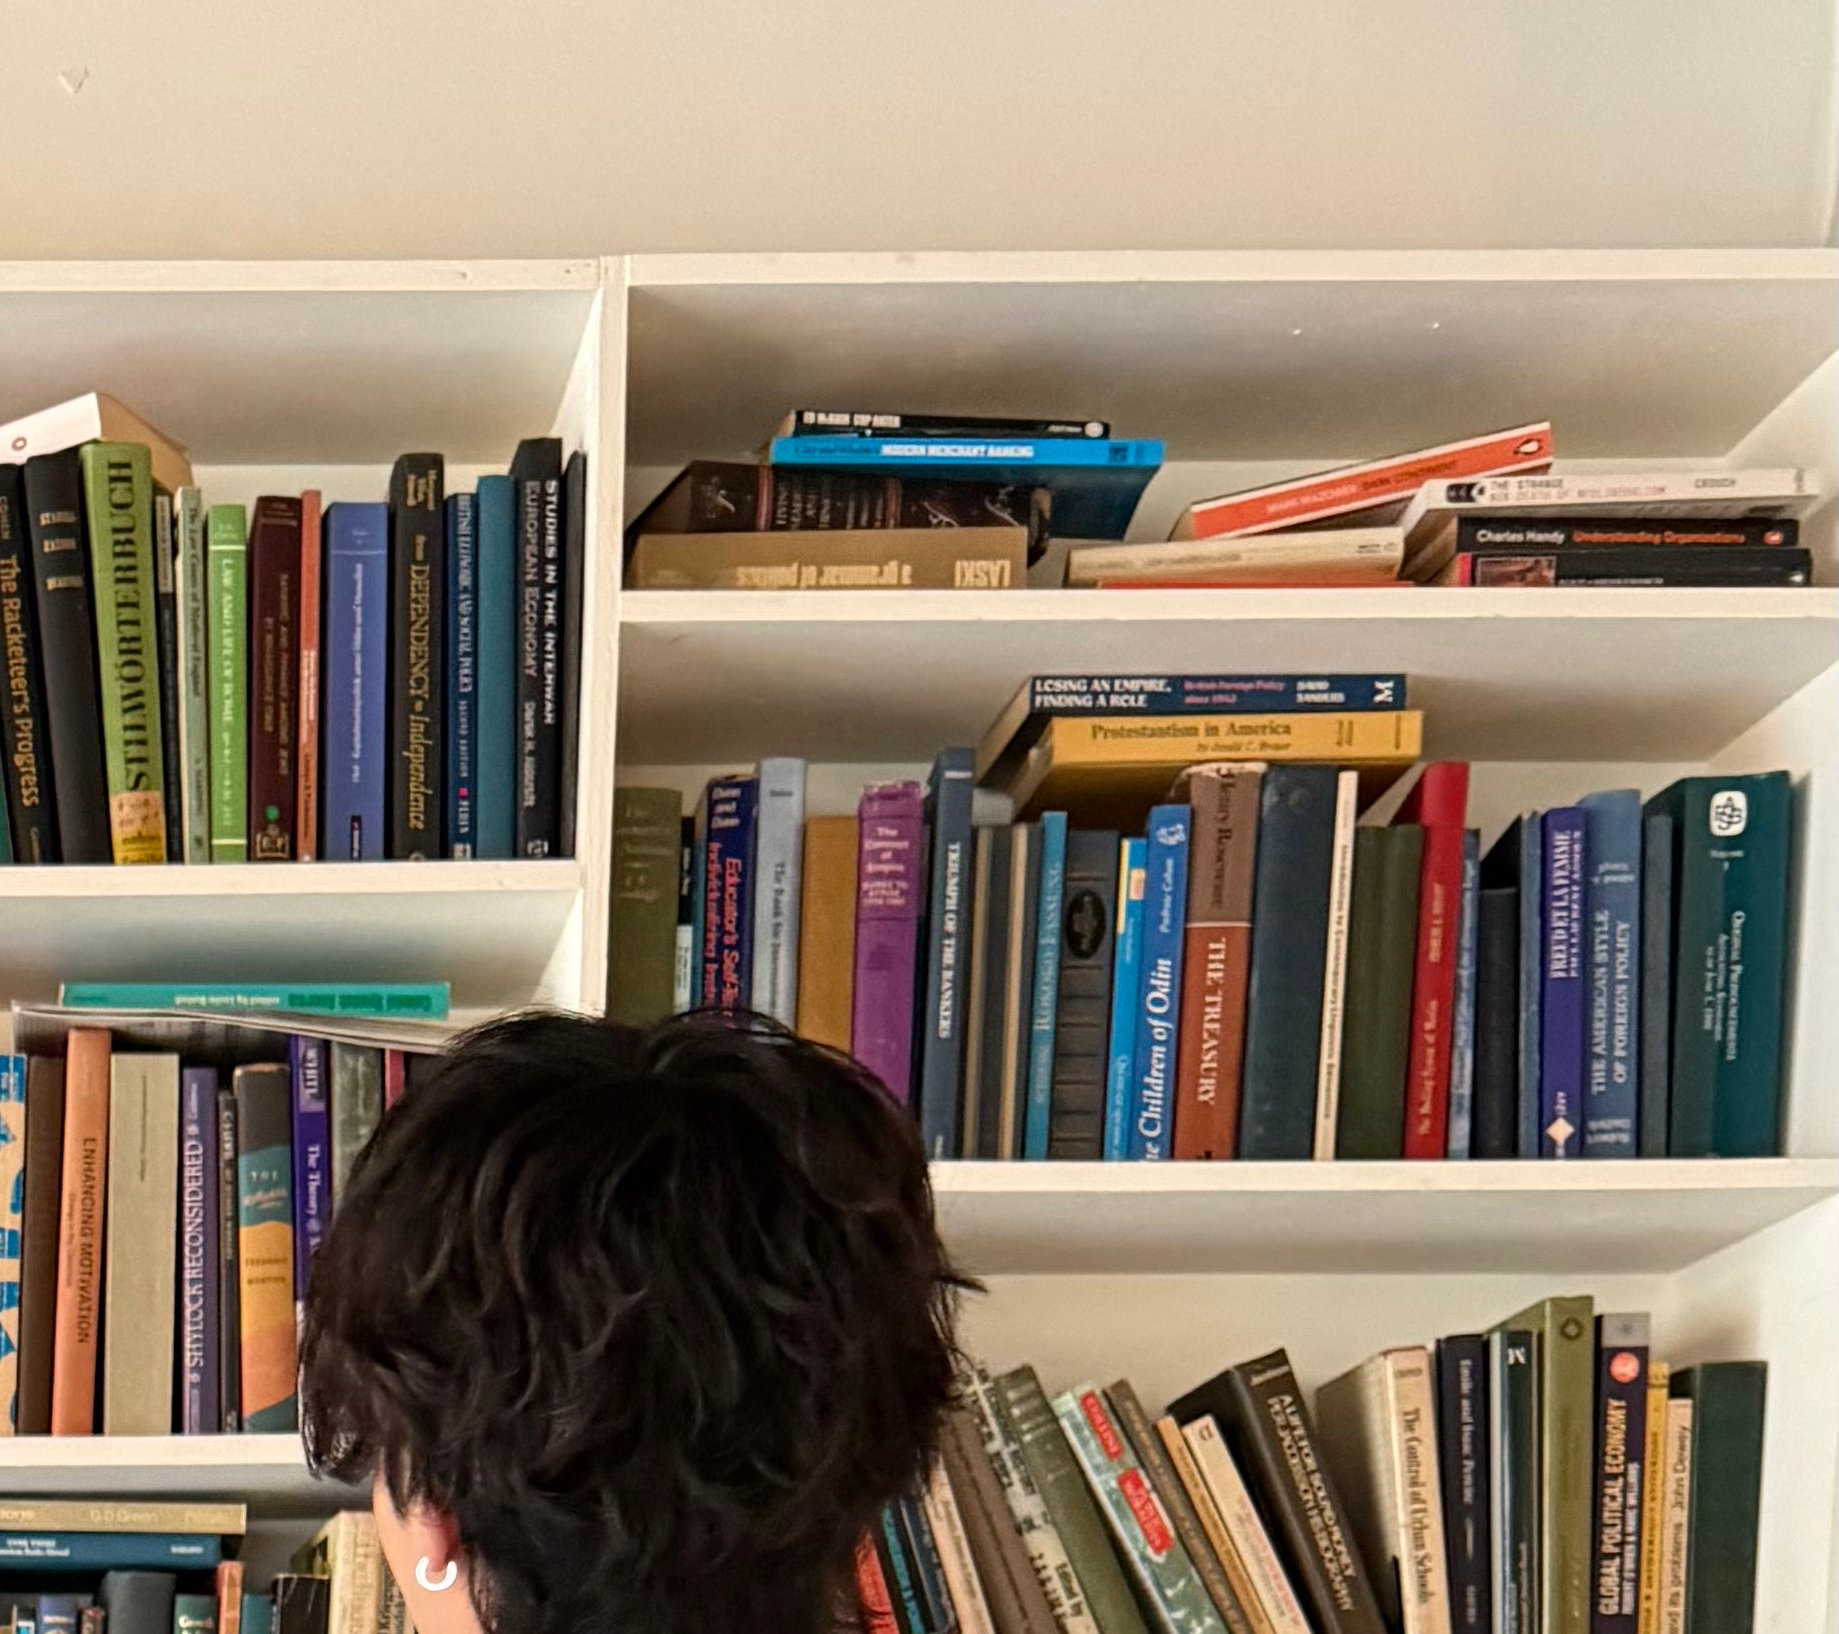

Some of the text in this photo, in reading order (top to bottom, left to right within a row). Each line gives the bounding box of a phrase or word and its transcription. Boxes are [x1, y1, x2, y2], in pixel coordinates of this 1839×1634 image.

[106, 460, 150, 793] STILWÖRTERBUCH
[525, 480, 541, 677] EUROPEAN ECONOMY
[543, 479, 558, 725] STUDIES IN THE INTERWAR
[1476, 528, 1522, 545] Charles
[1523, 530, 1566, 546] Handy
[1, 597, 30, 716] Racketeer's
[402, 563, 435, 830] DEPENDENCY Independence
[1034, 679, 1173, 695] LOSING AN EMPIRE,
[1091, 722, 1292, 741] Protestantism in America
[11, 717, 41, 807] Progress
[722, 858, 742, 945] Educator's
[939, 841, 960, 1039] TRIUMPH OF THE BANKERS
[1142, 958, 1172, 1138] Children of Odin
[1198, 938, 1226, 1106] THE TREASURY
[1592, 909, 1610, 1094] THE AMERICAN STYLE
[1613, 920, 1631, 1083] OF FOREIGN POLICY
[77, 1137, 96, 1344] ENHANCING MOTIVATION
[183, 1140, 204, 1367] SHYLOCK RECONSIDERED
[1602, 1398, 1628, 1615] GLOBAL POLITICAL ECONOMY
